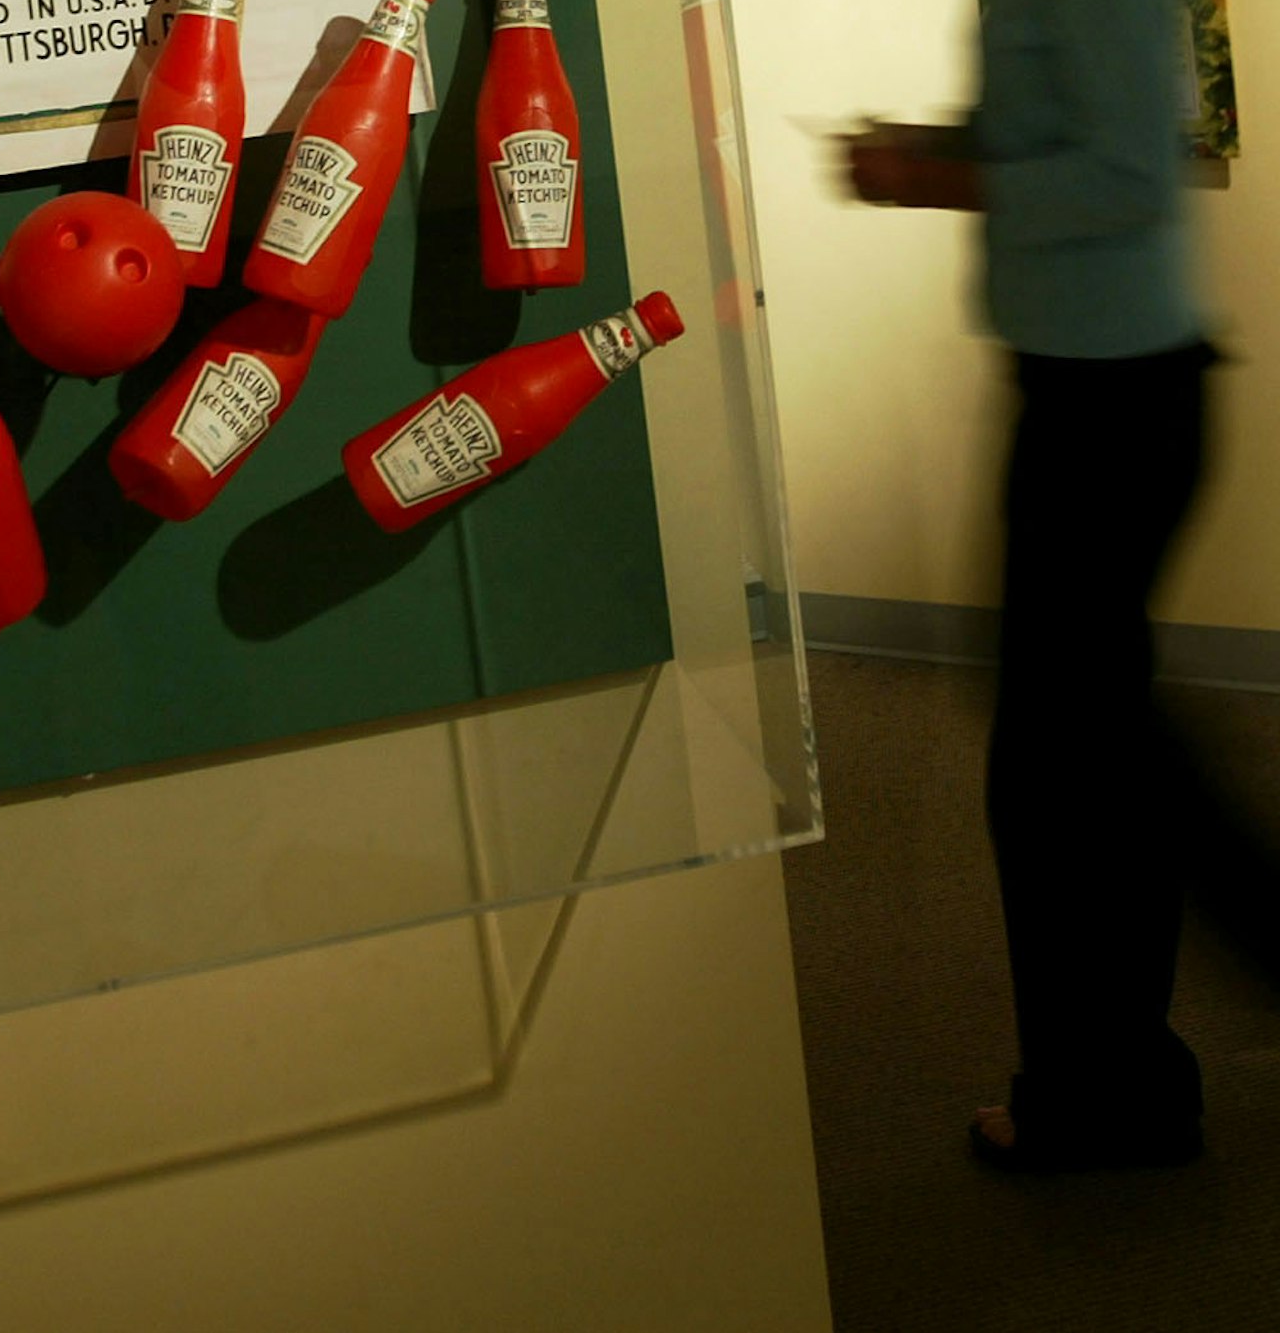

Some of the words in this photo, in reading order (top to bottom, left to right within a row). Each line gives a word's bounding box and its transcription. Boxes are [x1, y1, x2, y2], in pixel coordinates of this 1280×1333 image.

[167, 138, 213, 164] HEINZ
[297, 148, 338, 178] HEINZ
[513, 142, 558, 165] HEINZ
[157, 163, 217, 186] TOMATO
[287, 171, 336, 201] OMATO
[508, 169, 565, 184] TOMATO
[151, 186, 216, 206] KETCHUP
[280, 191, 331, 219] ETCHUP
[508, 188, 568, 205] KETCHUP
[233, 366, 272, 405] HEINZ
[200, 392, 249, 442] KETCHUP
[215, 380, 260, 429] TOMATO
[429, 416, 471, 474] TOMATO
[450, 405, 490, 455] HEINZ
[410, 426, 456, 485] KETCHUP
